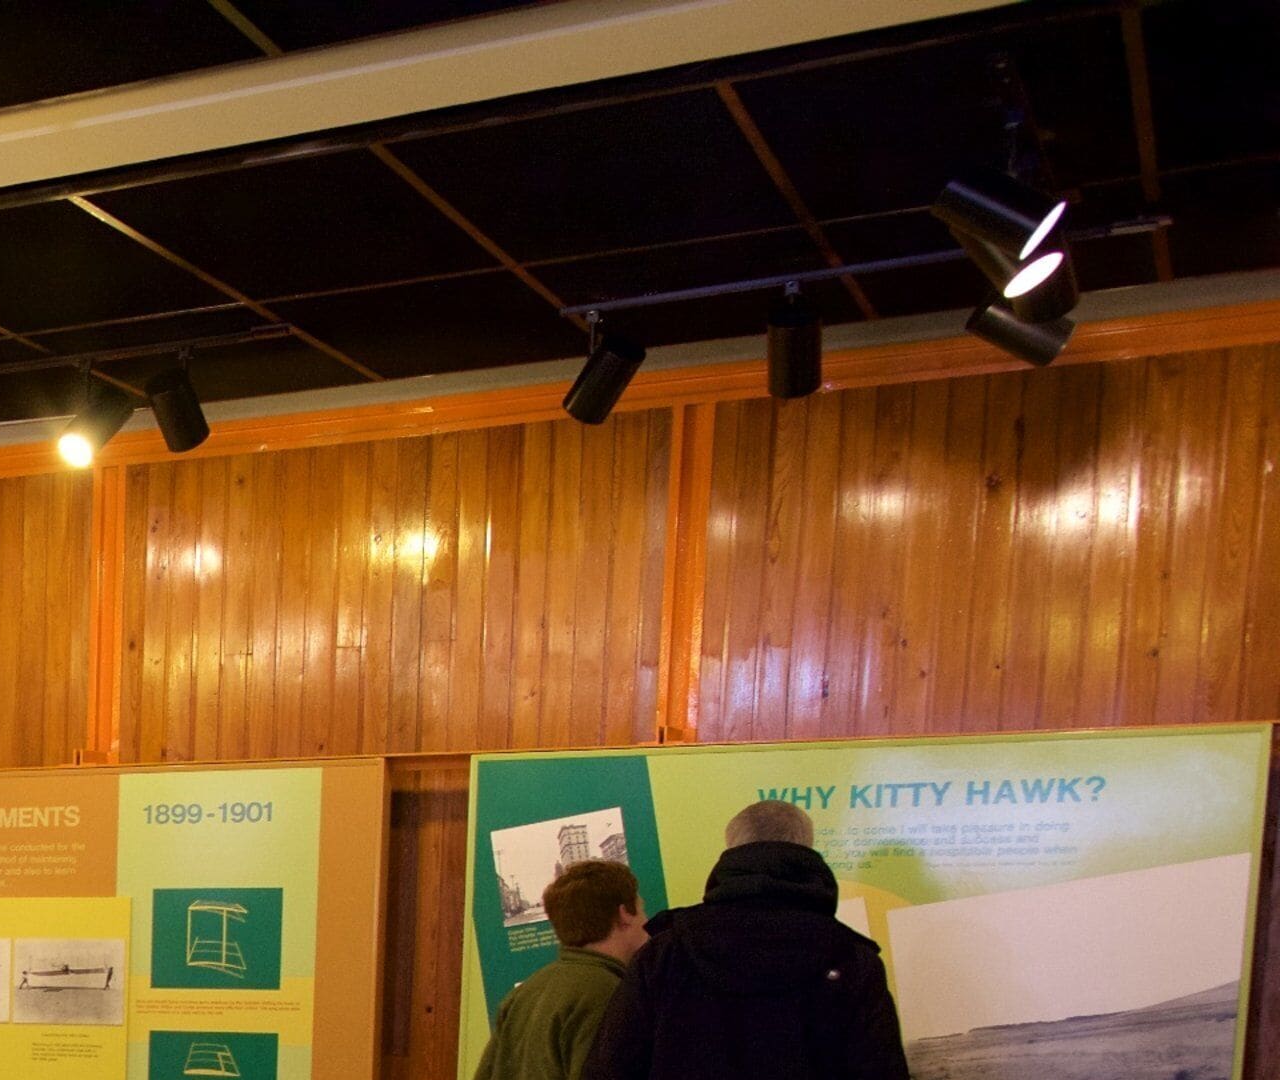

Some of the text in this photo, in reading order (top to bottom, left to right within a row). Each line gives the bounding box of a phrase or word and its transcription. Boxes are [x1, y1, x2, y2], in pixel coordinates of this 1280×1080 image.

[757, 775, 1107, 810] WHY KITTY HAWK?
